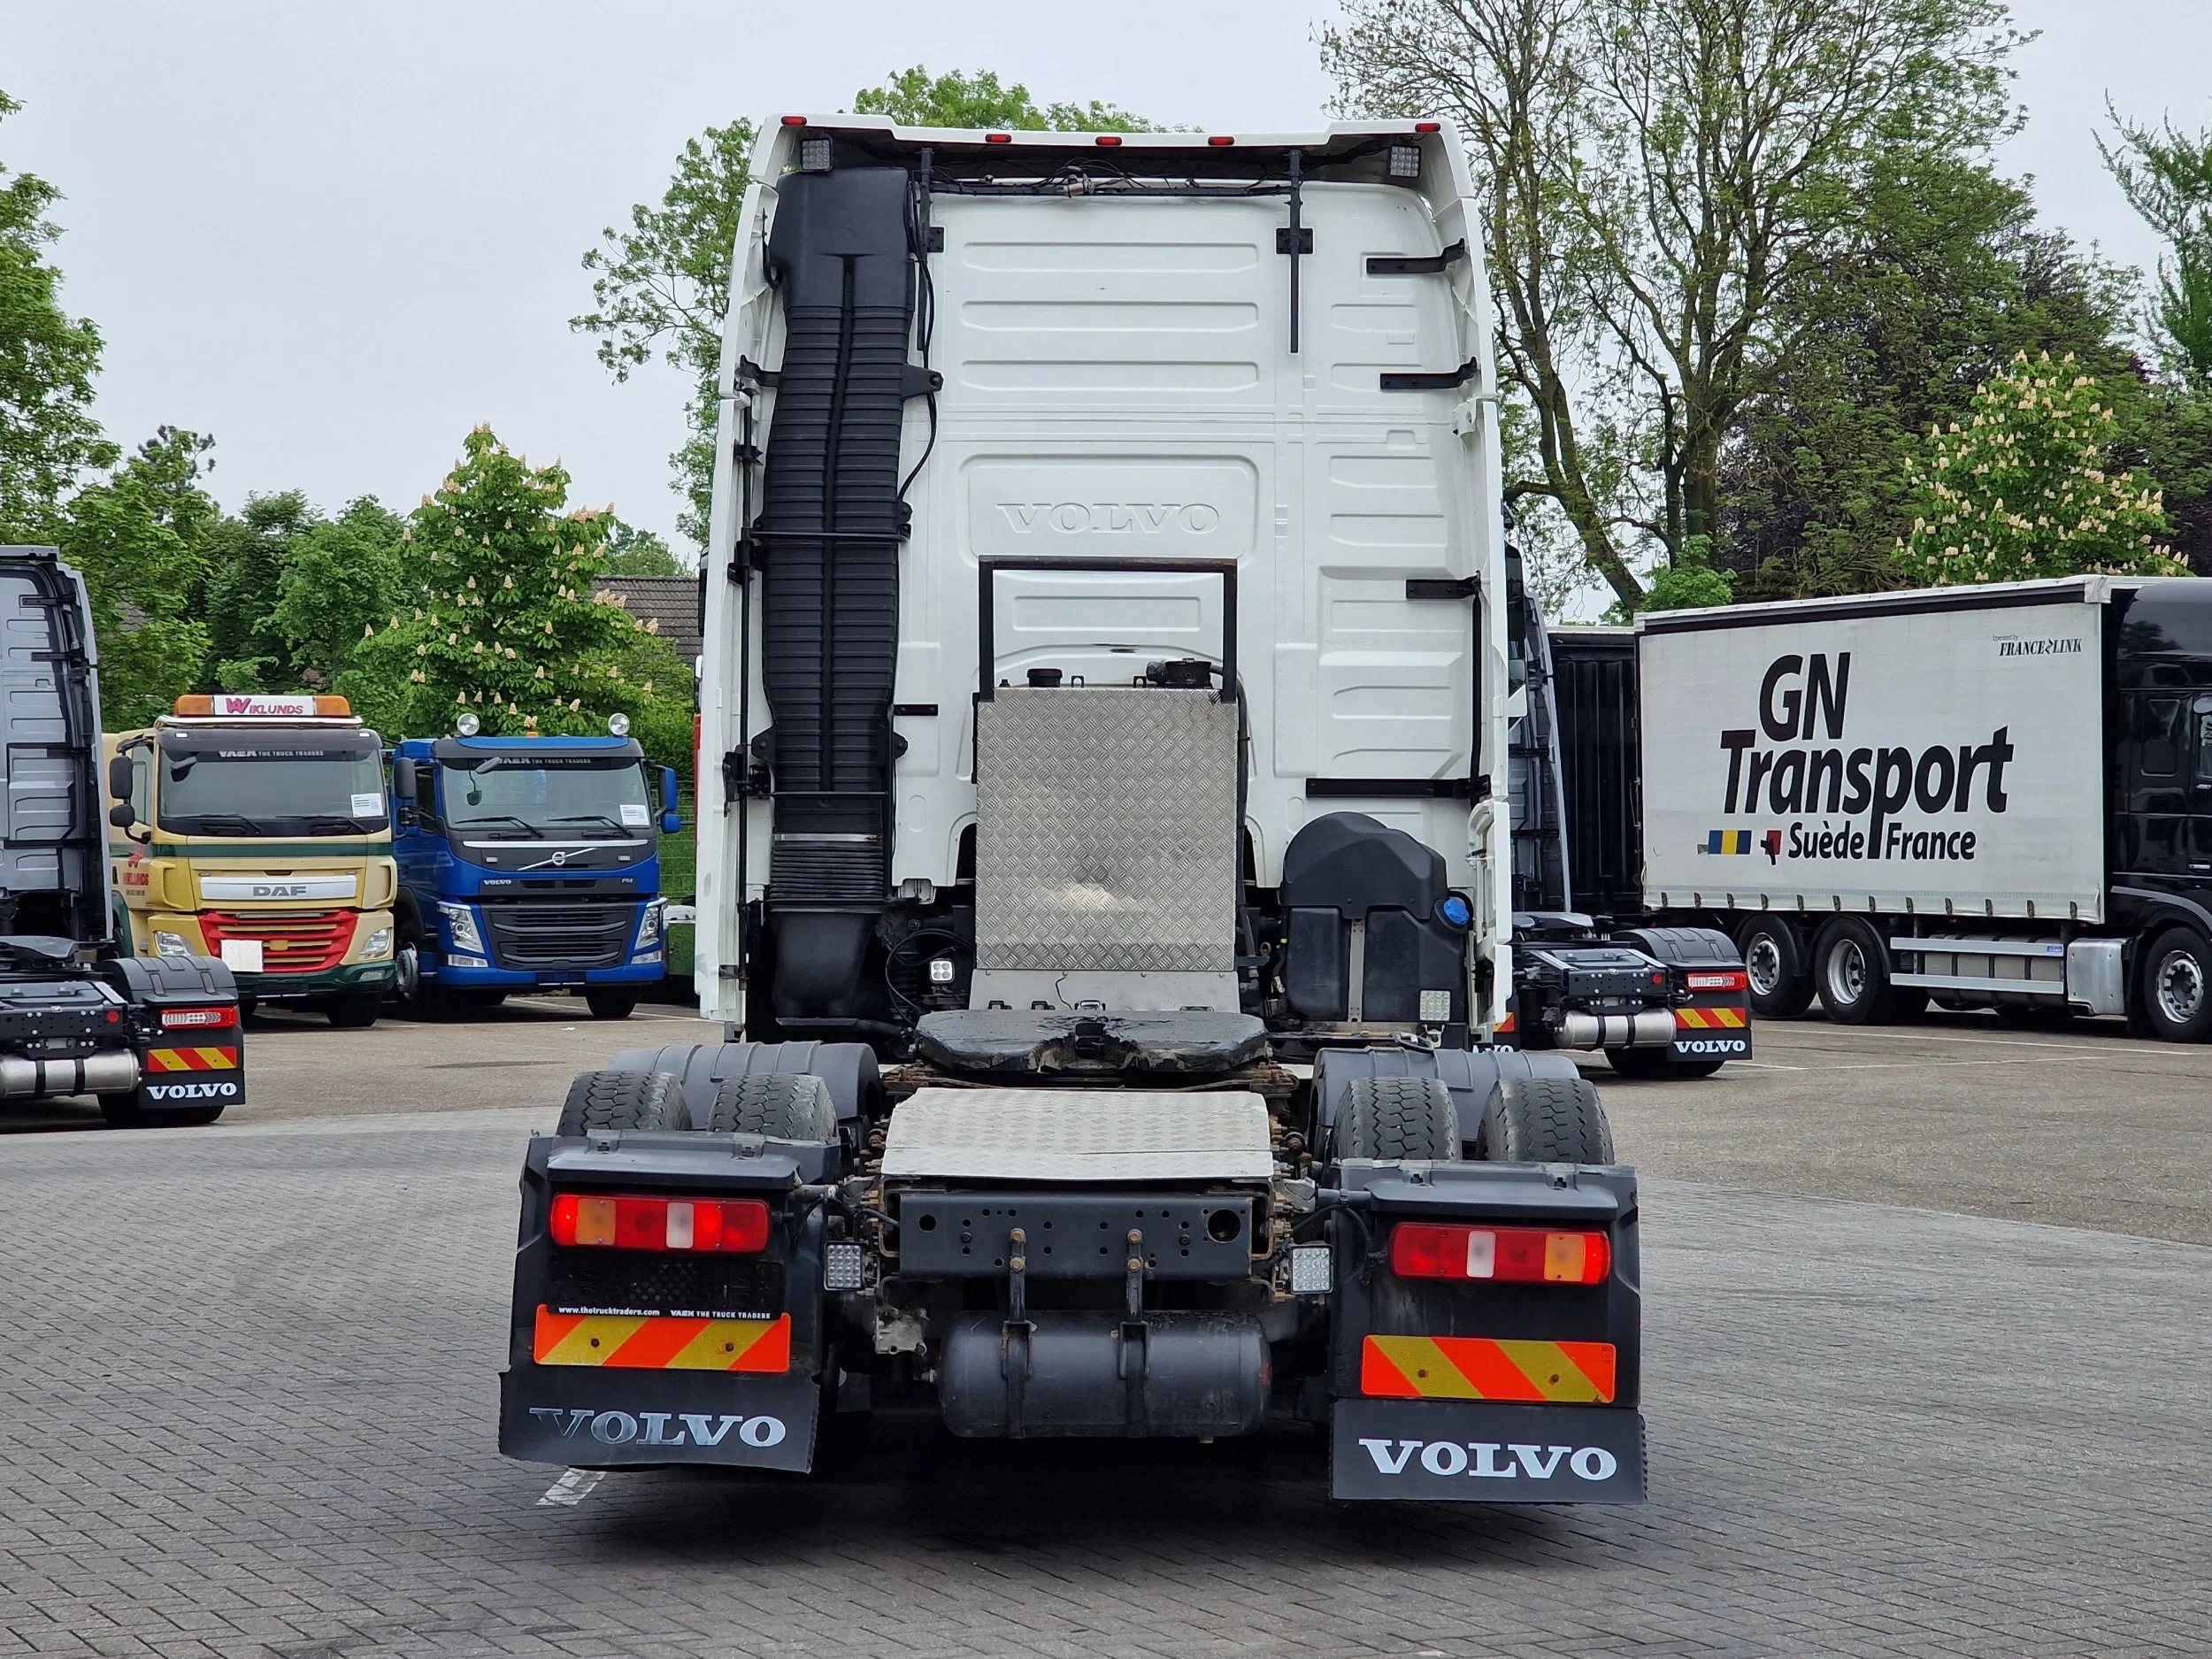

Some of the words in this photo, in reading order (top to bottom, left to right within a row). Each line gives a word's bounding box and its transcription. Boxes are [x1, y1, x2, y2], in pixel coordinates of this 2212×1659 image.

[995, 502, 1220, 534] VOLVO
[225, 697, 303, 715] WIKLUNDS
[1758, 651, 1852, 742] GN
[1720, 725, 2015, 860] Transport
[1788, 821, 1864, 860] Suède
[1885, 822, 1977, 860] France
[253, 886, 307, 896] DAF
[1673, 1040, 1747, 1053] VOLVO
[146, 1082, 237, 1100] VOLVO
[529, 1408, 787, 1448] VOLVO
[1358, 1438, 1617, 1480] VOLVO
